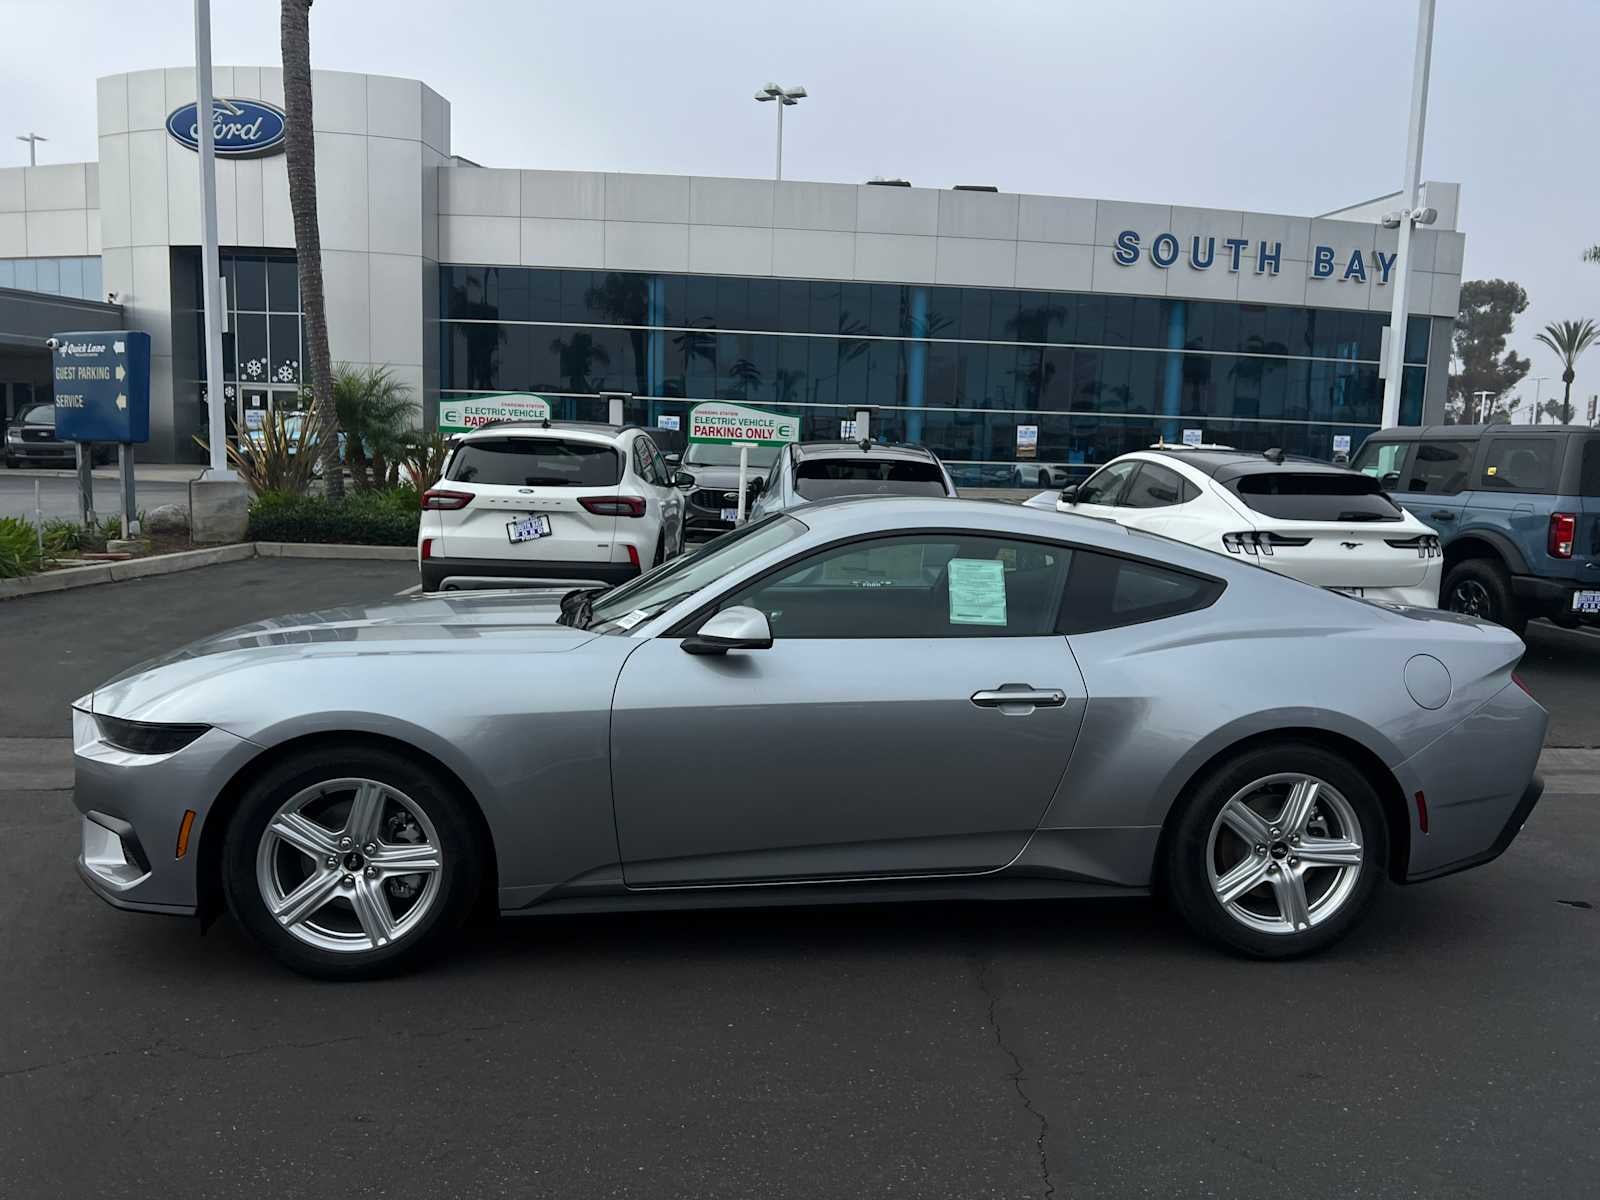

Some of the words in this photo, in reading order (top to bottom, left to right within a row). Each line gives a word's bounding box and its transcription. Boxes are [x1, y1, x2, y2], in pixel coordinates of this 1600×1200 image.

[1113, 230, 1283, 275] SOUTH
[1311, 245, 1398, 284] BAY
[67, 343, 87, 354] Quick
[87, 343, 106, 353] Lane
[55, 366, 76, 380] GUEST
[78, 366, 110, 380] PARKING
[55, 394, 84, 408] SERVICE
[464, 406, 507, 417] ELECTRIC
[508, 408, 545, 418] VEHICLE
[694, 416, 737, 426] ELECTRIC
[738, 417, 775, 428] VEHICLE
[694, 425, 743, 438] PARKING
[745, 427, 775, 440] ONLY
